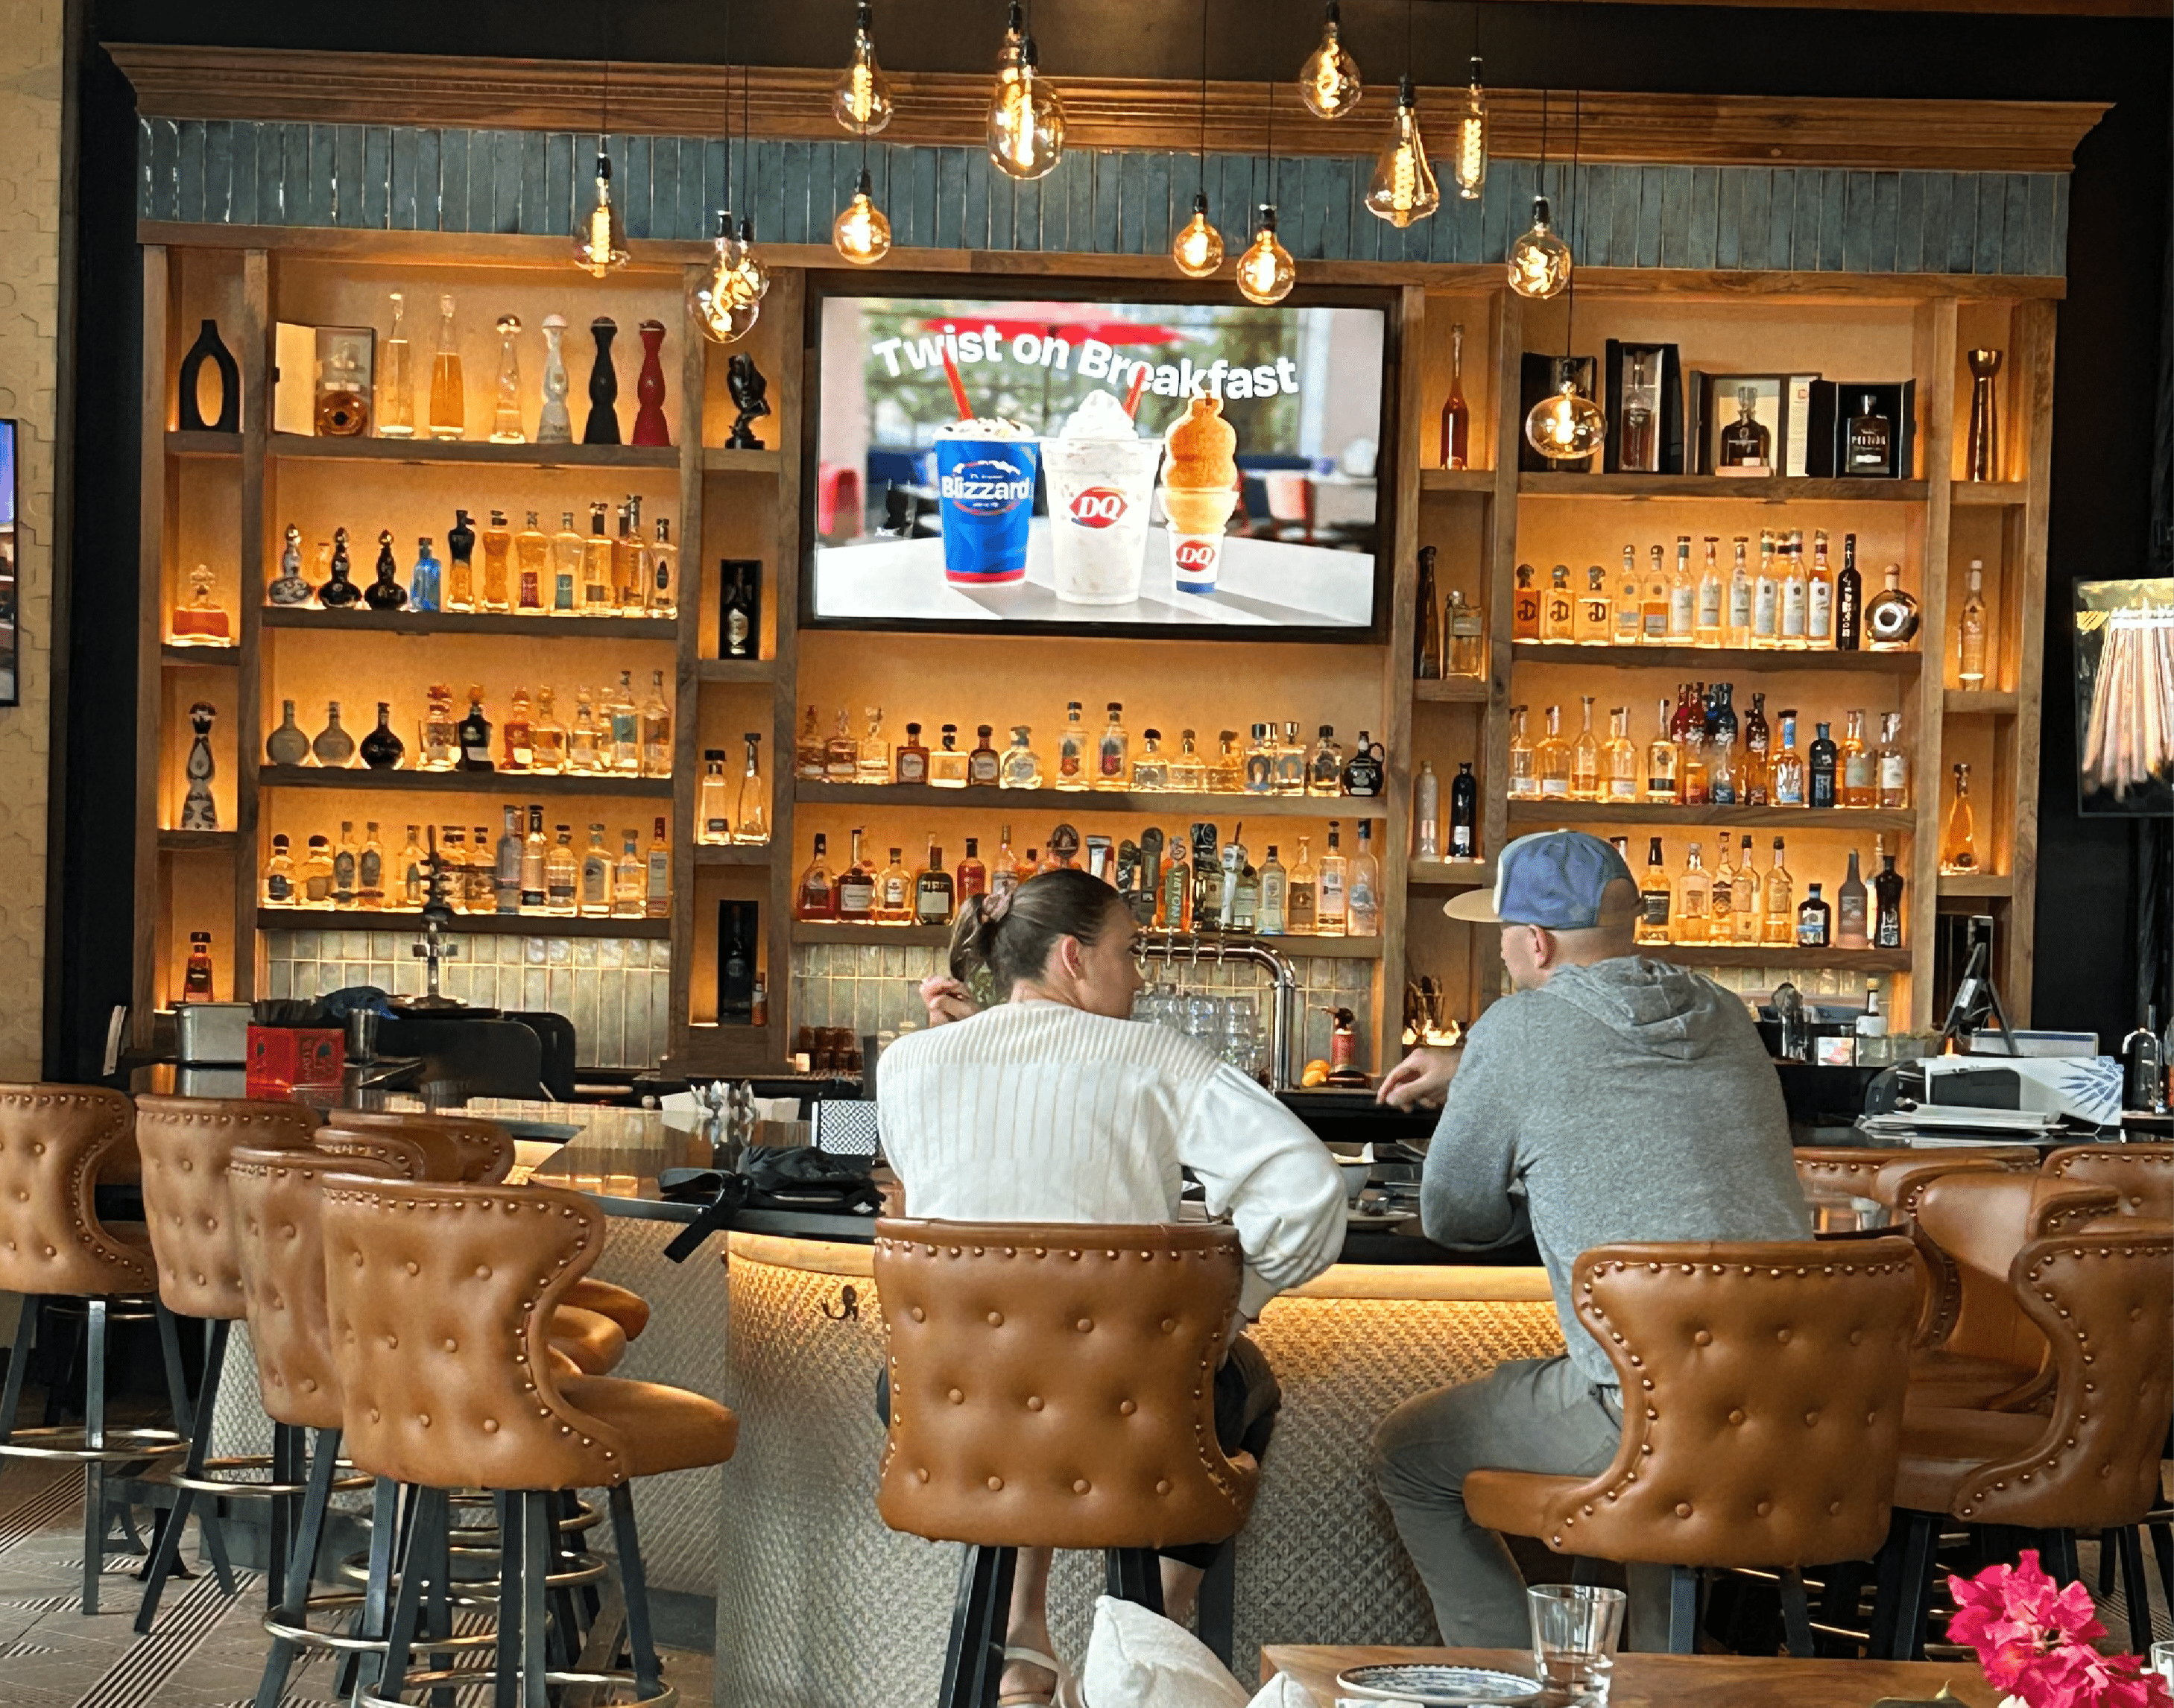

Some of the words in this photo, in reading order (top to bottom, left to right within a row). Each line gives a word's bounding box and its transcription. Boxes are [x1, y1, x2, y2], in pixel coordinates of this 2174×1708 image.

[871, 324, 1002, 377] Twist
[1012, 333, 1069, 370] on
[1078, 338, 1299, 399] Breakfast
[941, 476, 1029, 500] Blizzard
[1078, 496, 1121, 519] DQ
[1181, 547, 1213, 565] DQ
